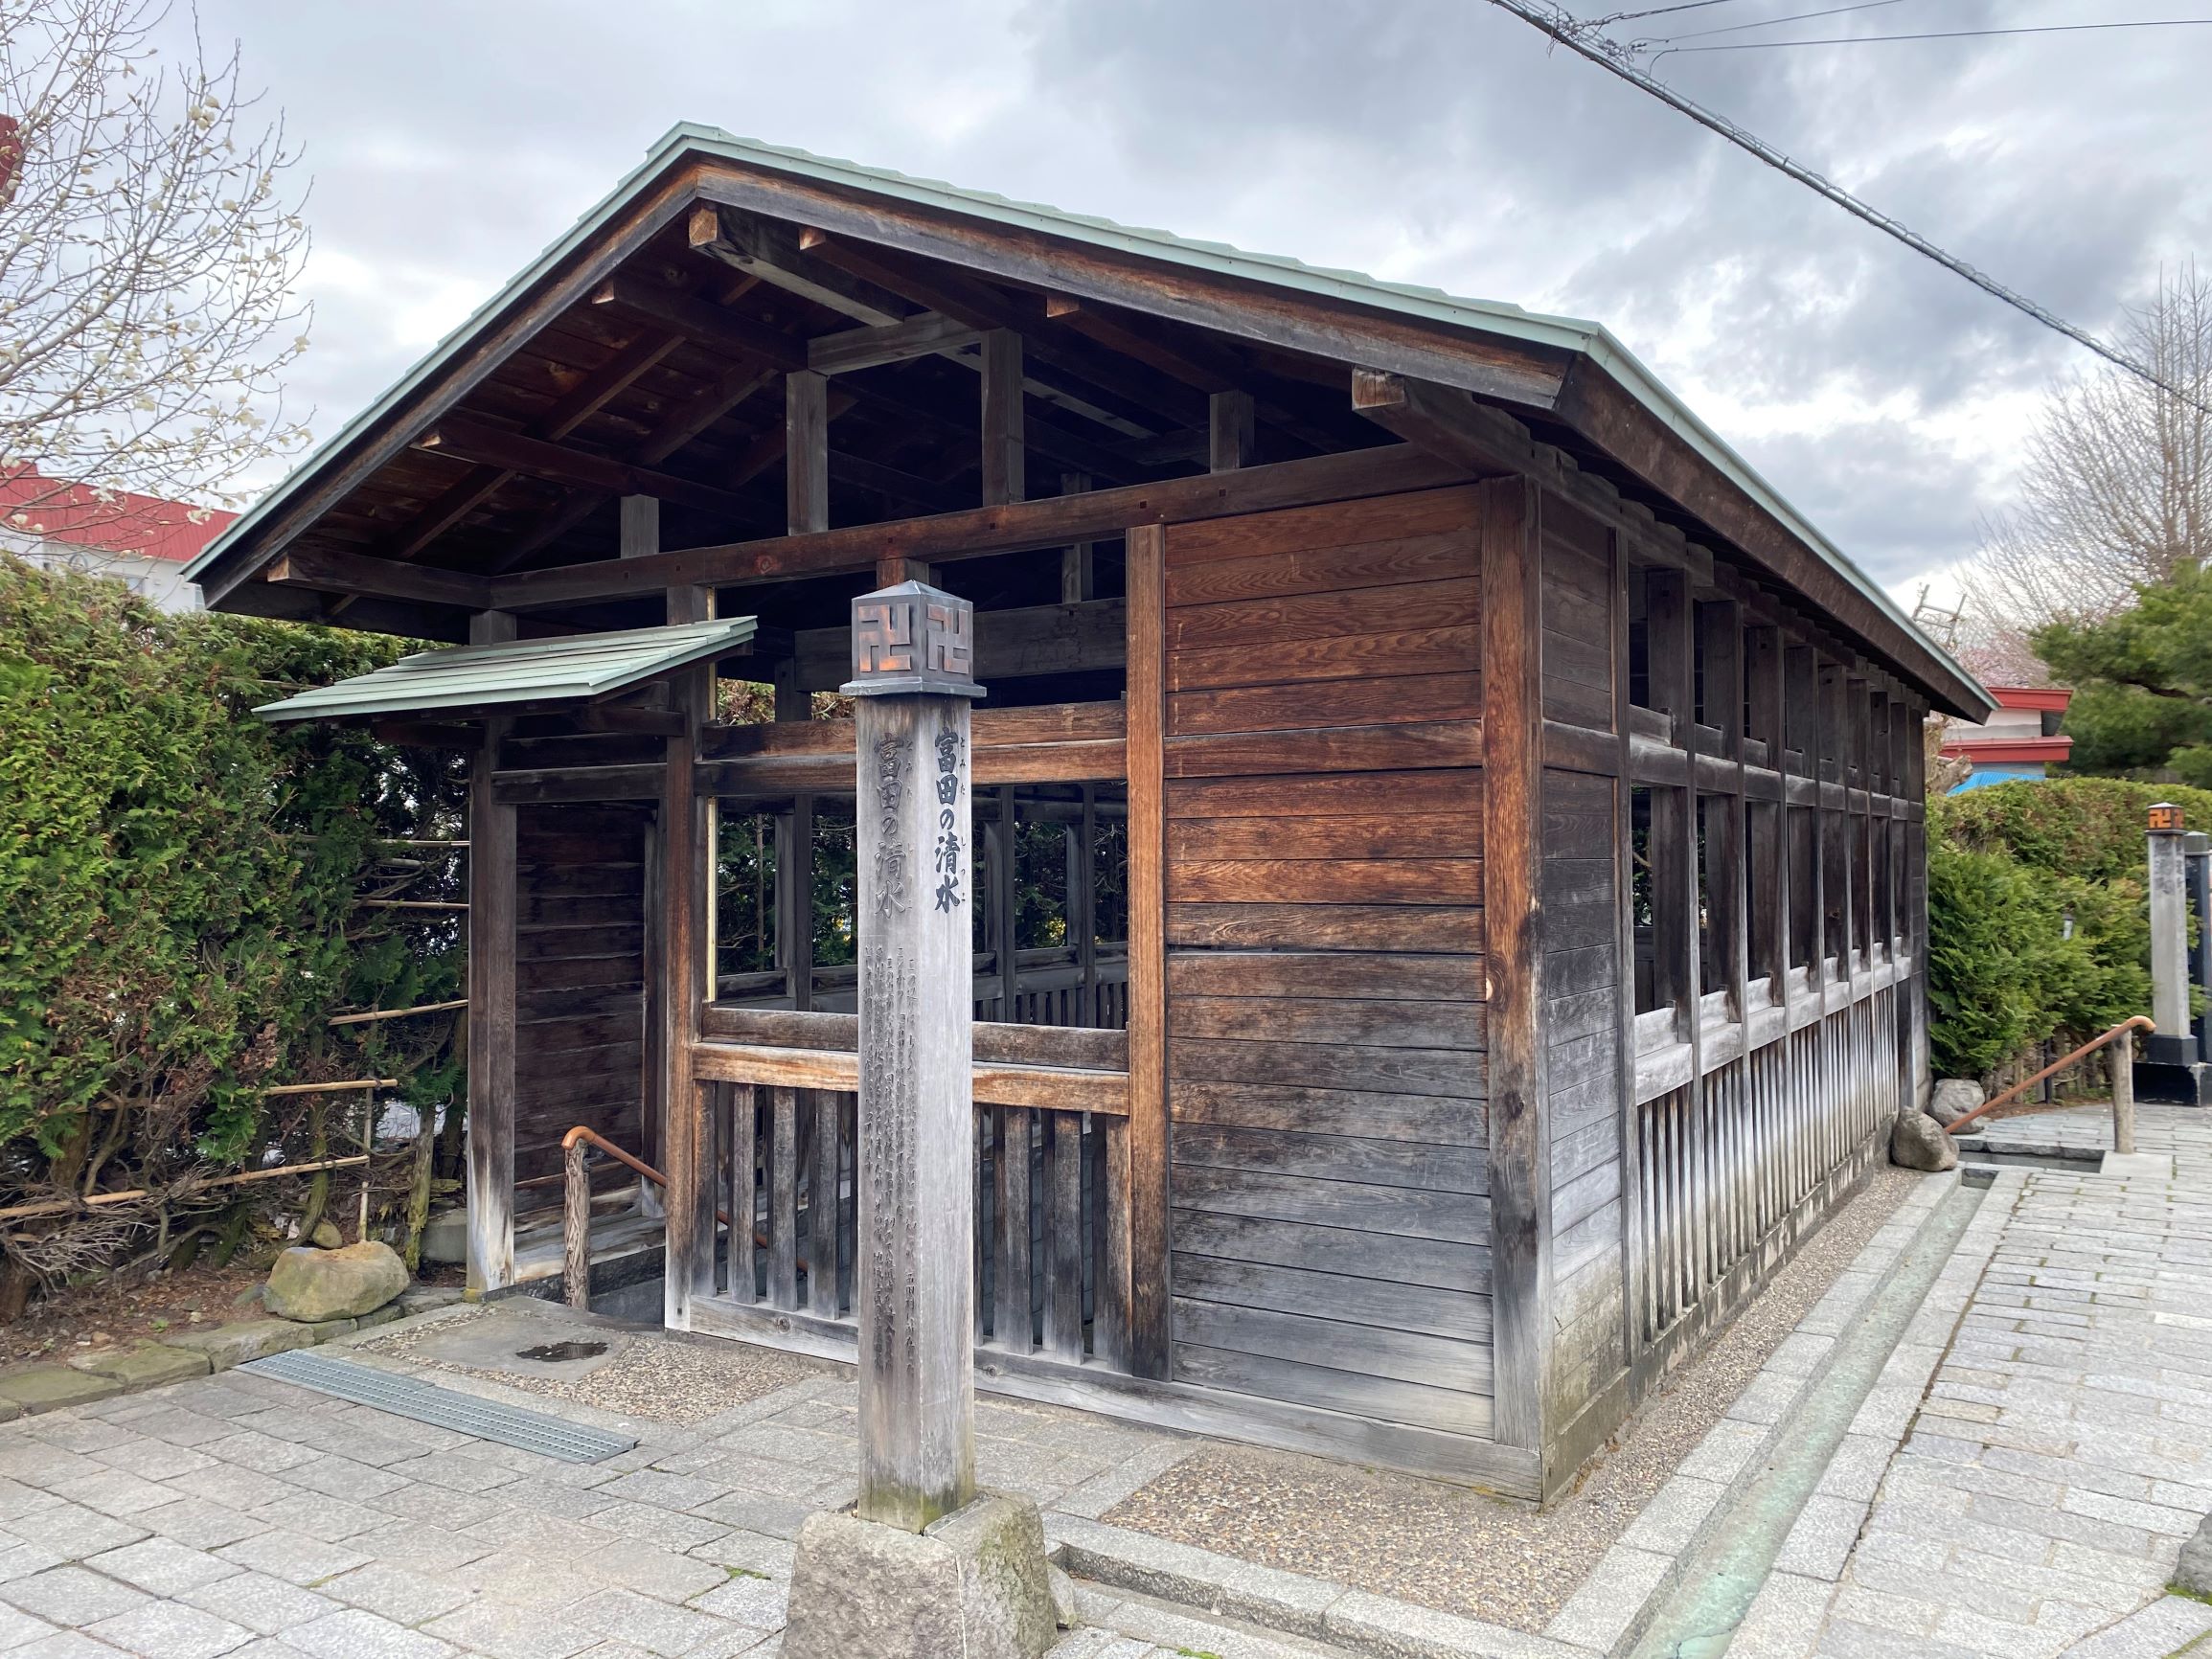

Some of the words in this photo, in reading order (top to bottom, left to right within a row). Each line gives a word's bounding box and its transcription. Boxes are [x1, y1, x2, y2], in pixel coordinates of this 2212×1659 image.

[875, 732, 906, 919] 富田の清水
[935, 727, 961, 914] 富田の清水
